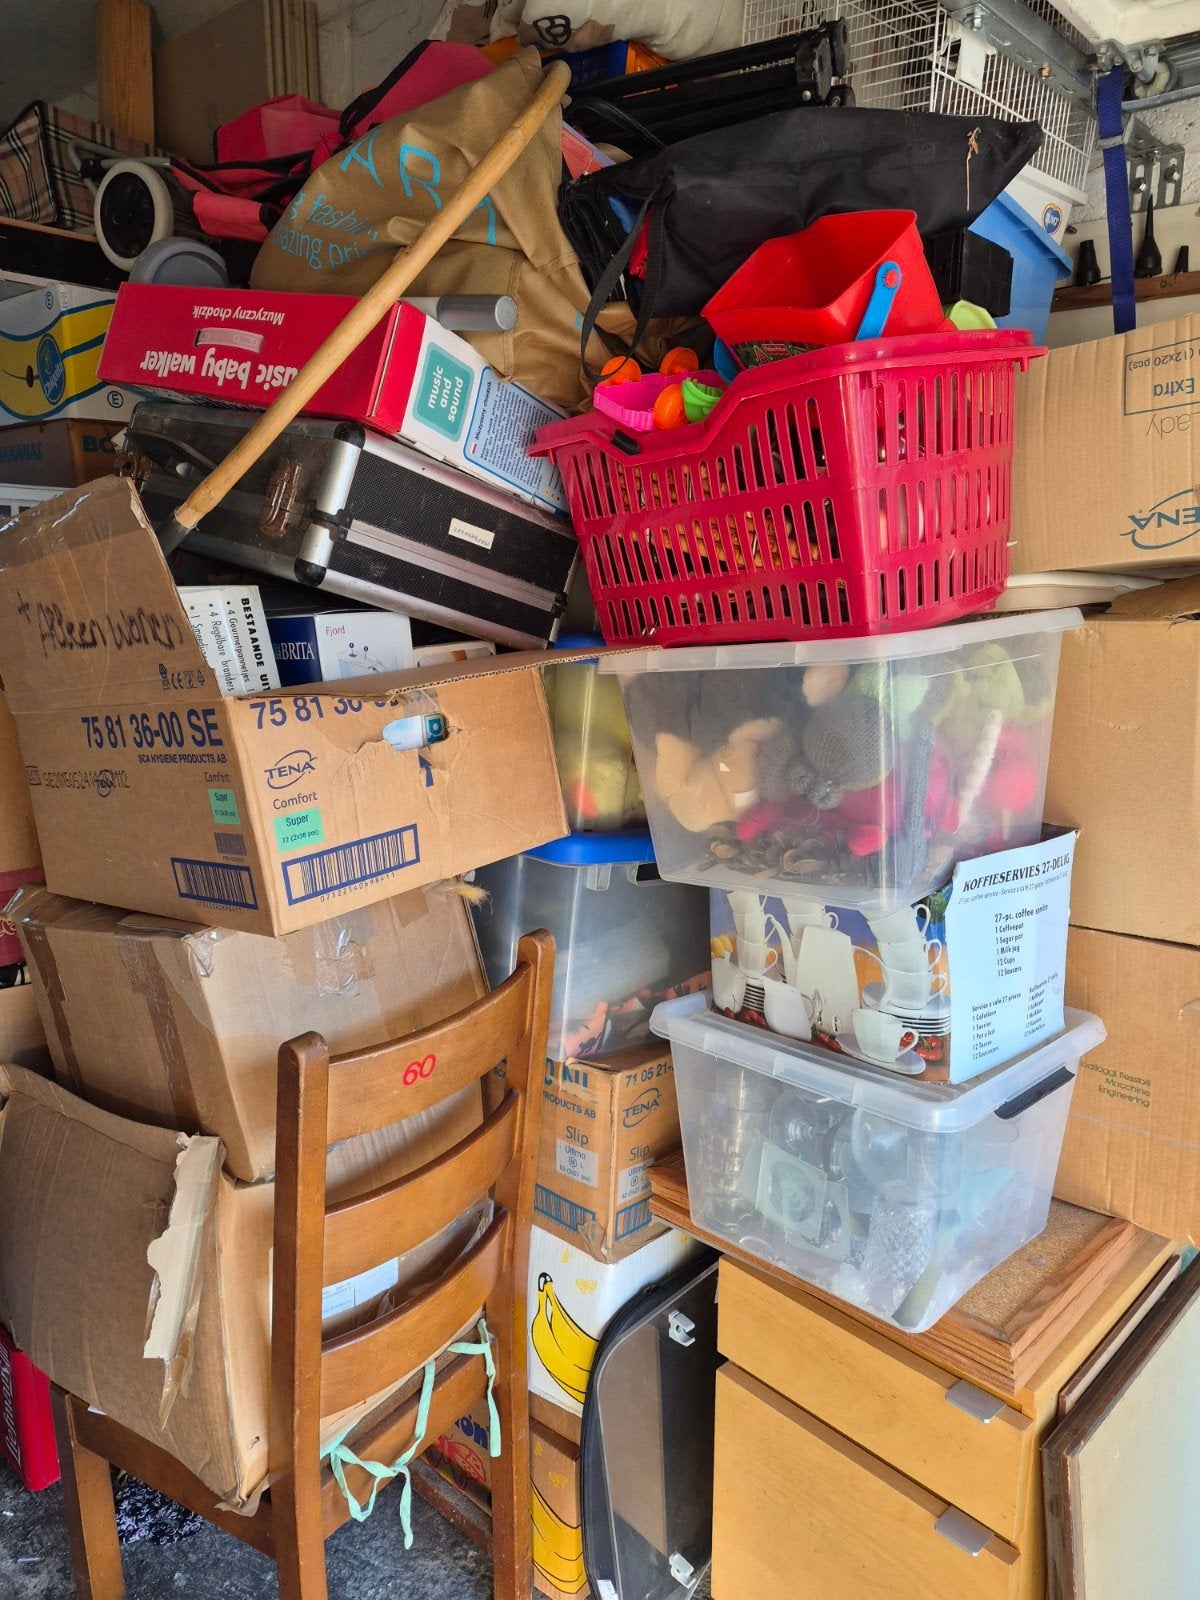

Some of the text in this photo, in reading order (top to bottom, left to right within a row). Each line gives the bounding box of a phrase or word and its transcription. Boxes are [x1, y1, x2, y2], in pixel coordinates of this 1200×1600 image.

[192, 305, 285, 326] Muzyczny chodzik
[139, 347, 298, 391] usic baby walker
[1128, 358, 1150, 372] pcs)
[428, 365, 444, 409] music
[441, 377, 452, 408] and
[1153, 377, 1195, 397] Extra
[448, 376, 464, 422] sound
[1145, 411, 1200, 440] ady
[1128, 506, 1200, 531] ENA
[241, 598, 265, 667] BESTAANDE
[326, 626, 345, 637] Fjord
[211, 621, 226, 656] Regelbare
[221, 660, 236, 692] branders
[281, 642, 315, 660] BRITA
[250, 698, 287, 730] 75
[293, 696, 324, 722] 81
[81, 708, 224, 749] 75 81 36-00 SE
[138, 754, 227, 764] SCA HYGIENE PRODUCTS AB
[204, 771, 230, 783] Comfort
[264, 760, 316, 780] TENA
[273, 791, 318, 810] Comfort
[286, 814, 309, 828] Super
[962, 864, 1040, 892] KOFFIESERVIES
[1041, 853, 1070, 874] 27-DELIG
[994, 913, 1014, 923] 27-pc.
[1015, 908, 1034, 919] coffee
[1000, 923, 1024, 933] Coffeepot
[1000, 935, 1013, 944] Sugar
[1000, 946, 1011, 954] Milk
[1004, 957, 1015, 965] Cups
[1004, 966, 1021, 976] Saucers
[402, 1054, 436, 1086] 60
[625, 1063, 674, 1088] 71 05 21-
[1080, 1060, 1117, 1077] ballaggi
[1098, 1084, 1150, 1108] Engineering
[1106, 1078, 1150, 1097] Macchine
[543, 1090, 597, 1119] RODUCTS AB
[623, 1098, 661, 1119] TENA
[566, 1125, 589, 1147] Slip
[630, 1145, 650, 1161] Slip
